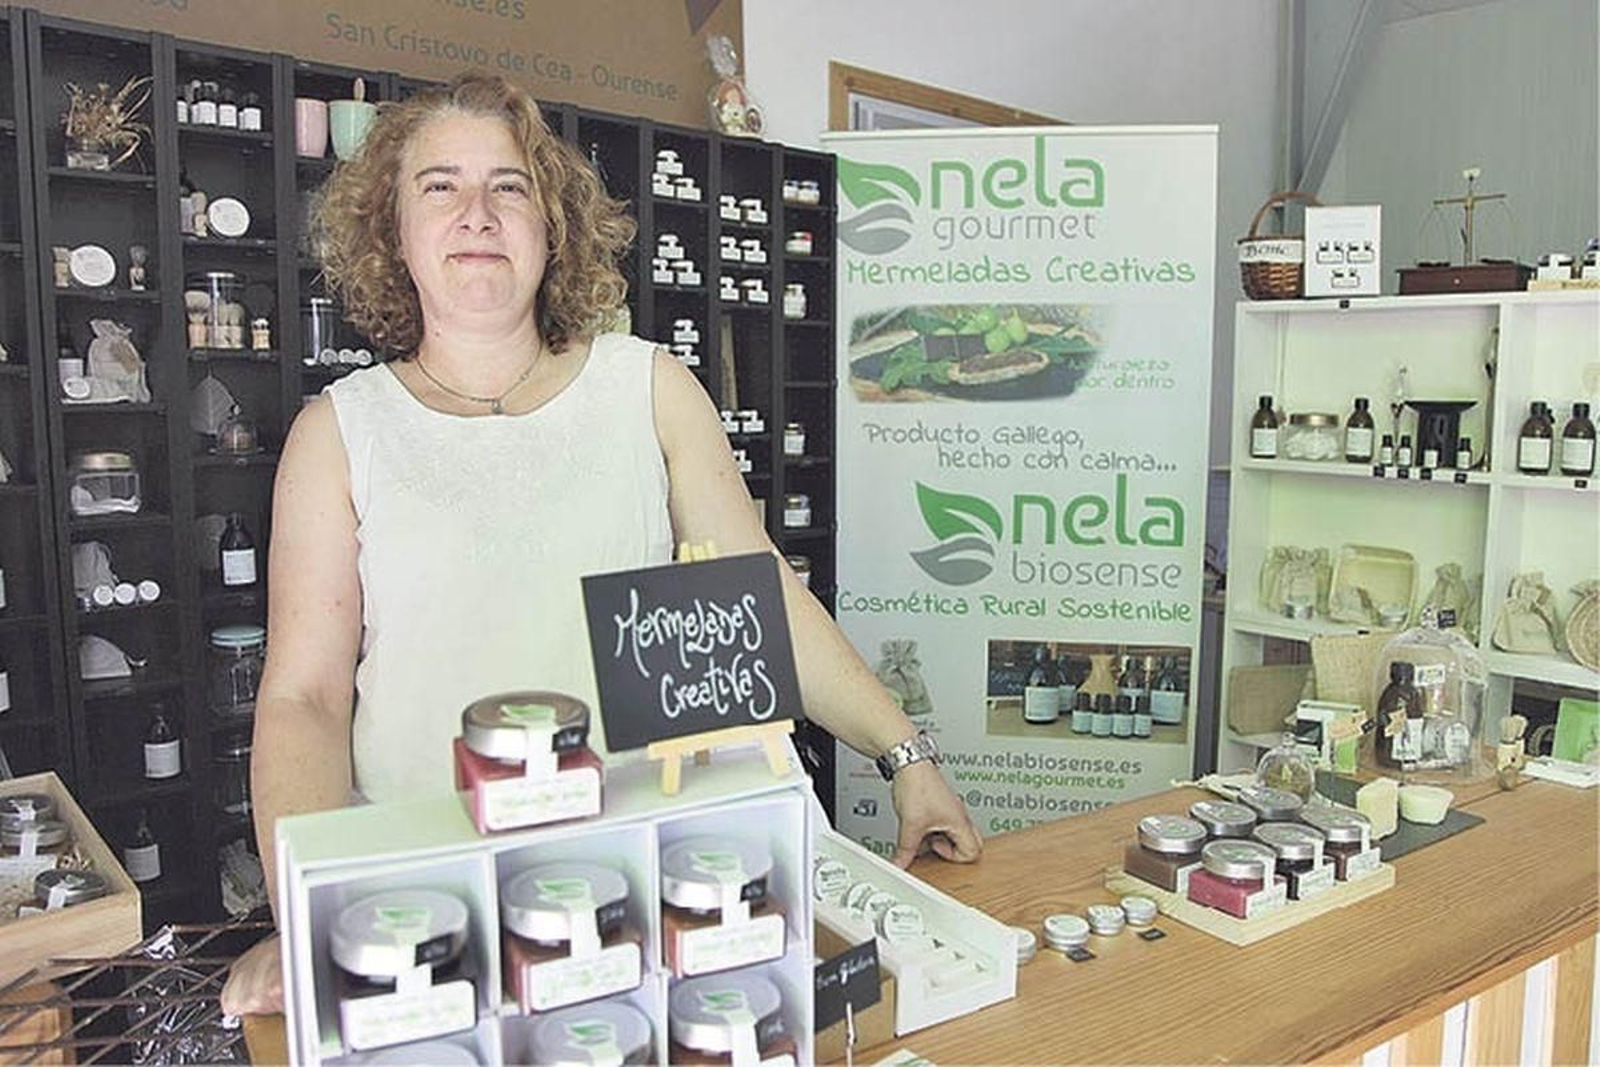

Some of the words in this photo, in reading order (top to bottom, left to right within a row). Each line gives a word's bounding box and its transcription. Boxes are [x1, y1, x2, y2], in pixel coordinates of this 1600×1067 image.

[325, 13, 375, 45] San
[384, 24, 489, 66] Cristovo
[498, 49, 527, 71] de
[533, 52, 572, 81] Cea
[591, 63, 681, 102] Ourense
[930, 136, 1105, 210] nela
[933, 213, 1097, 250] gourmet
[846, 256, 1031, 284] Mermeladas
[1046, 256, 1196, 283] Creativas
[863, 422, 981, 445] Producto
[993, 426, 1085, 451] Gallego,
[938, 446, 1011, 470] hecho
[1023, 449, 1069, 471] con
[1081, 448, 1178, 472] calma...
[1012, 473, 1185, 547] nela
[1012, 550, 1183, 588] biosense
[839, 590, 969, 614] Cosmética
[983, 594, 1046, 617] Rural
[1057, 597, 1193, 622] Sostenible
[613, 588, 762, 678] Mermeladas
[661, 652, 776, 720] Creativas
[955, 770, 1126, 789] www.nelagourmet.es
